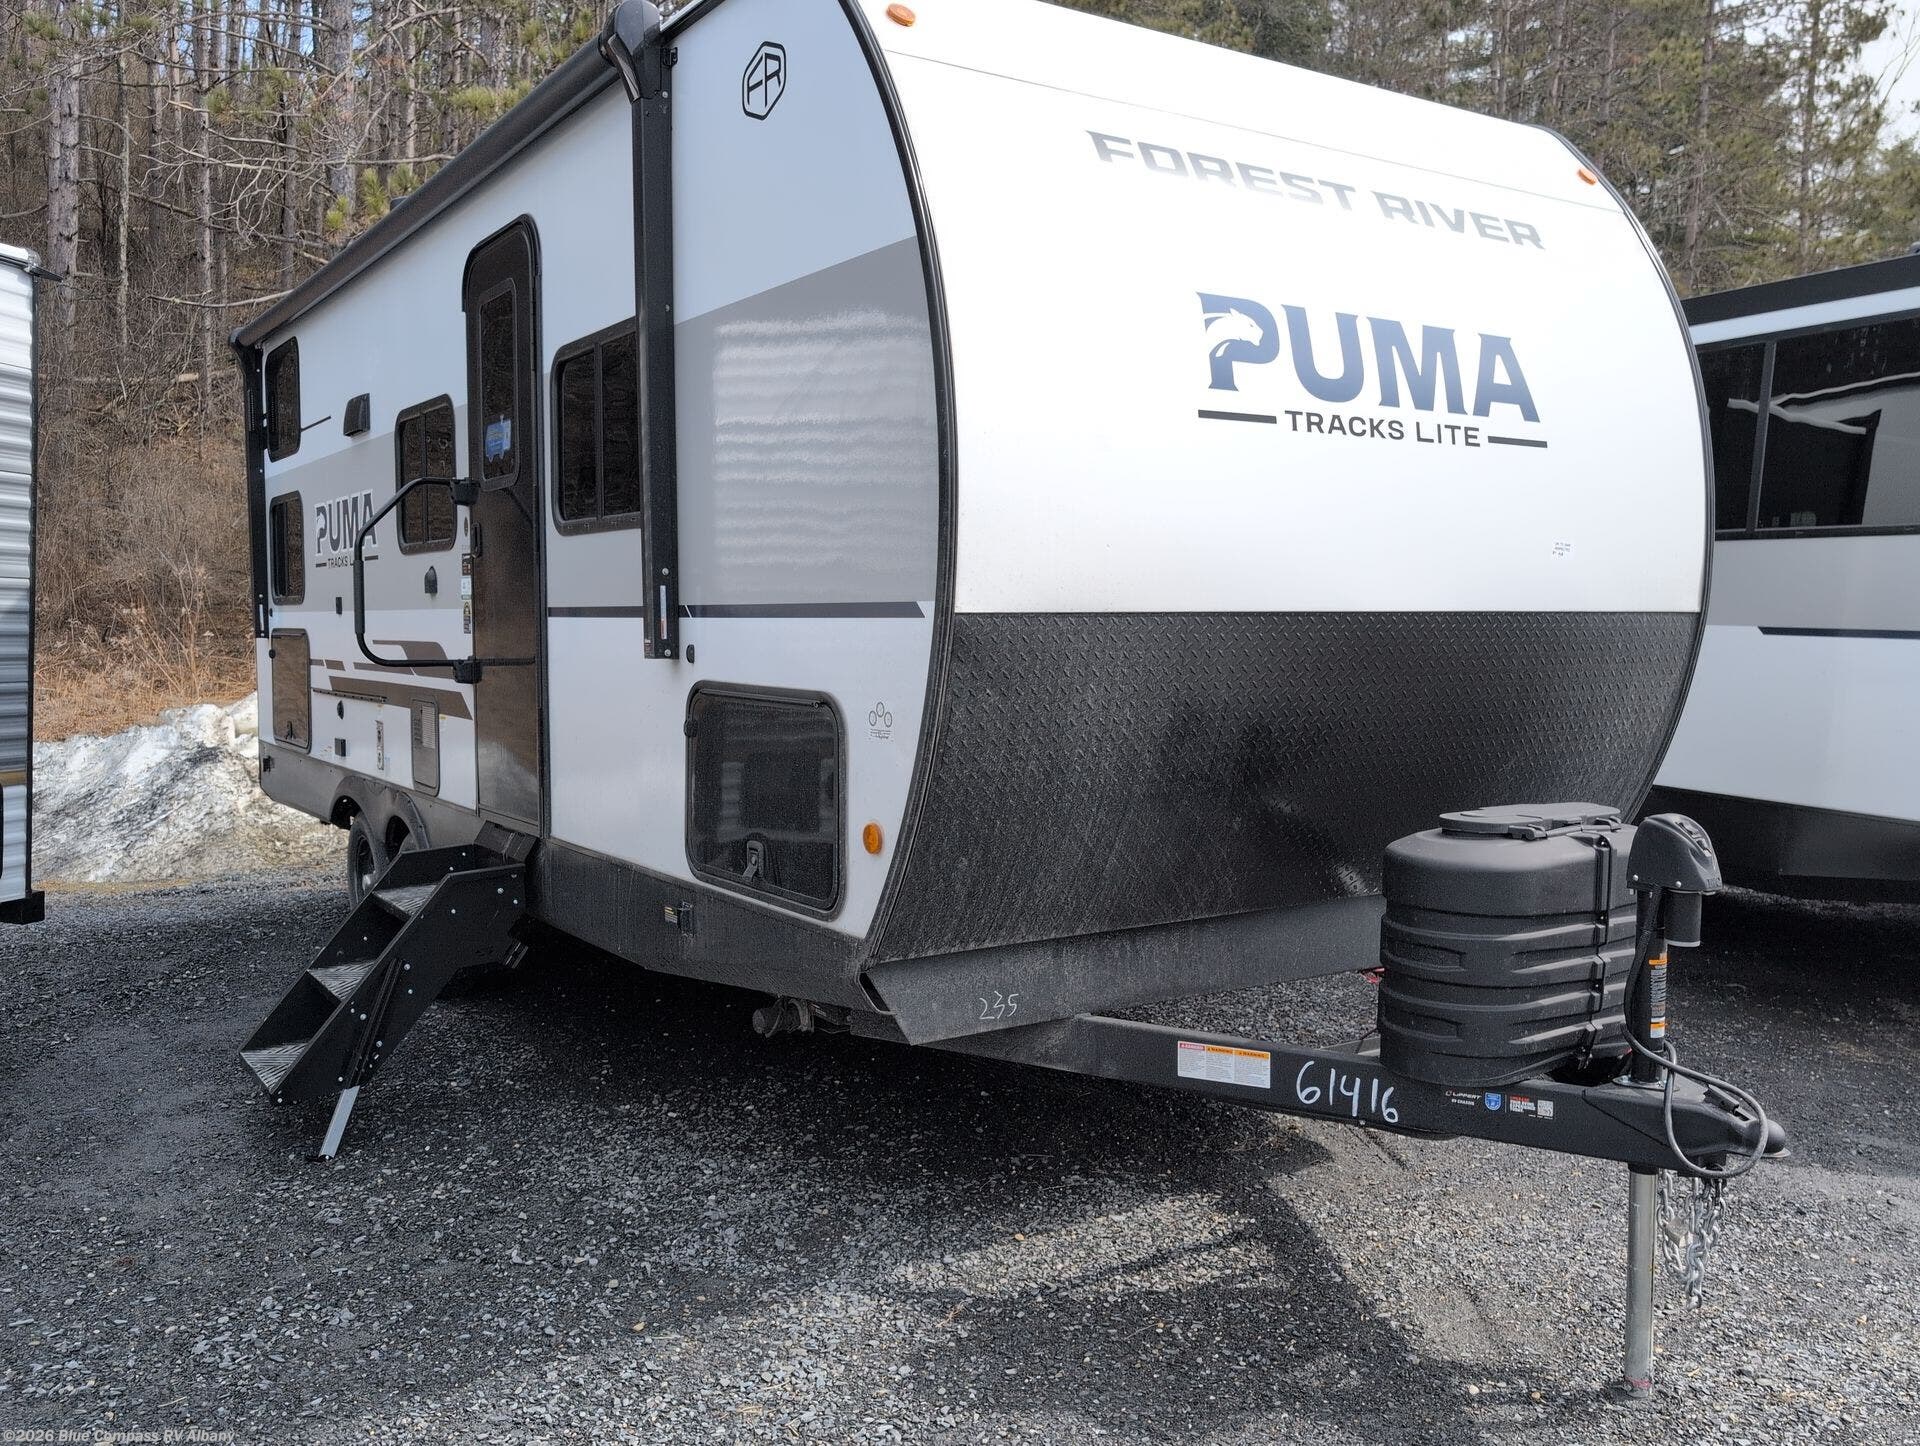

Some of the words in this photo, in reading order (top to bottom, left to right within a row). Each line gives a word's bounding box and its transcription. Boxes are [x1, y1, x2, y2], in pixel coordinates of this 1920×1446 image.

[1086, 129, 1356, 211] FOREST
[1370, 190, 1546, 250] RIVER
[1196, 291, 1541, 424] PUMA
[1284, 409, 1405, 441] TRACKS
[1415, 421, 1481, 448] LITE
[315, 491, 377, 554] PUMA
[979, 990, 1019, 1020] 235
[1296, 1060, 1399, 1123] 61416
